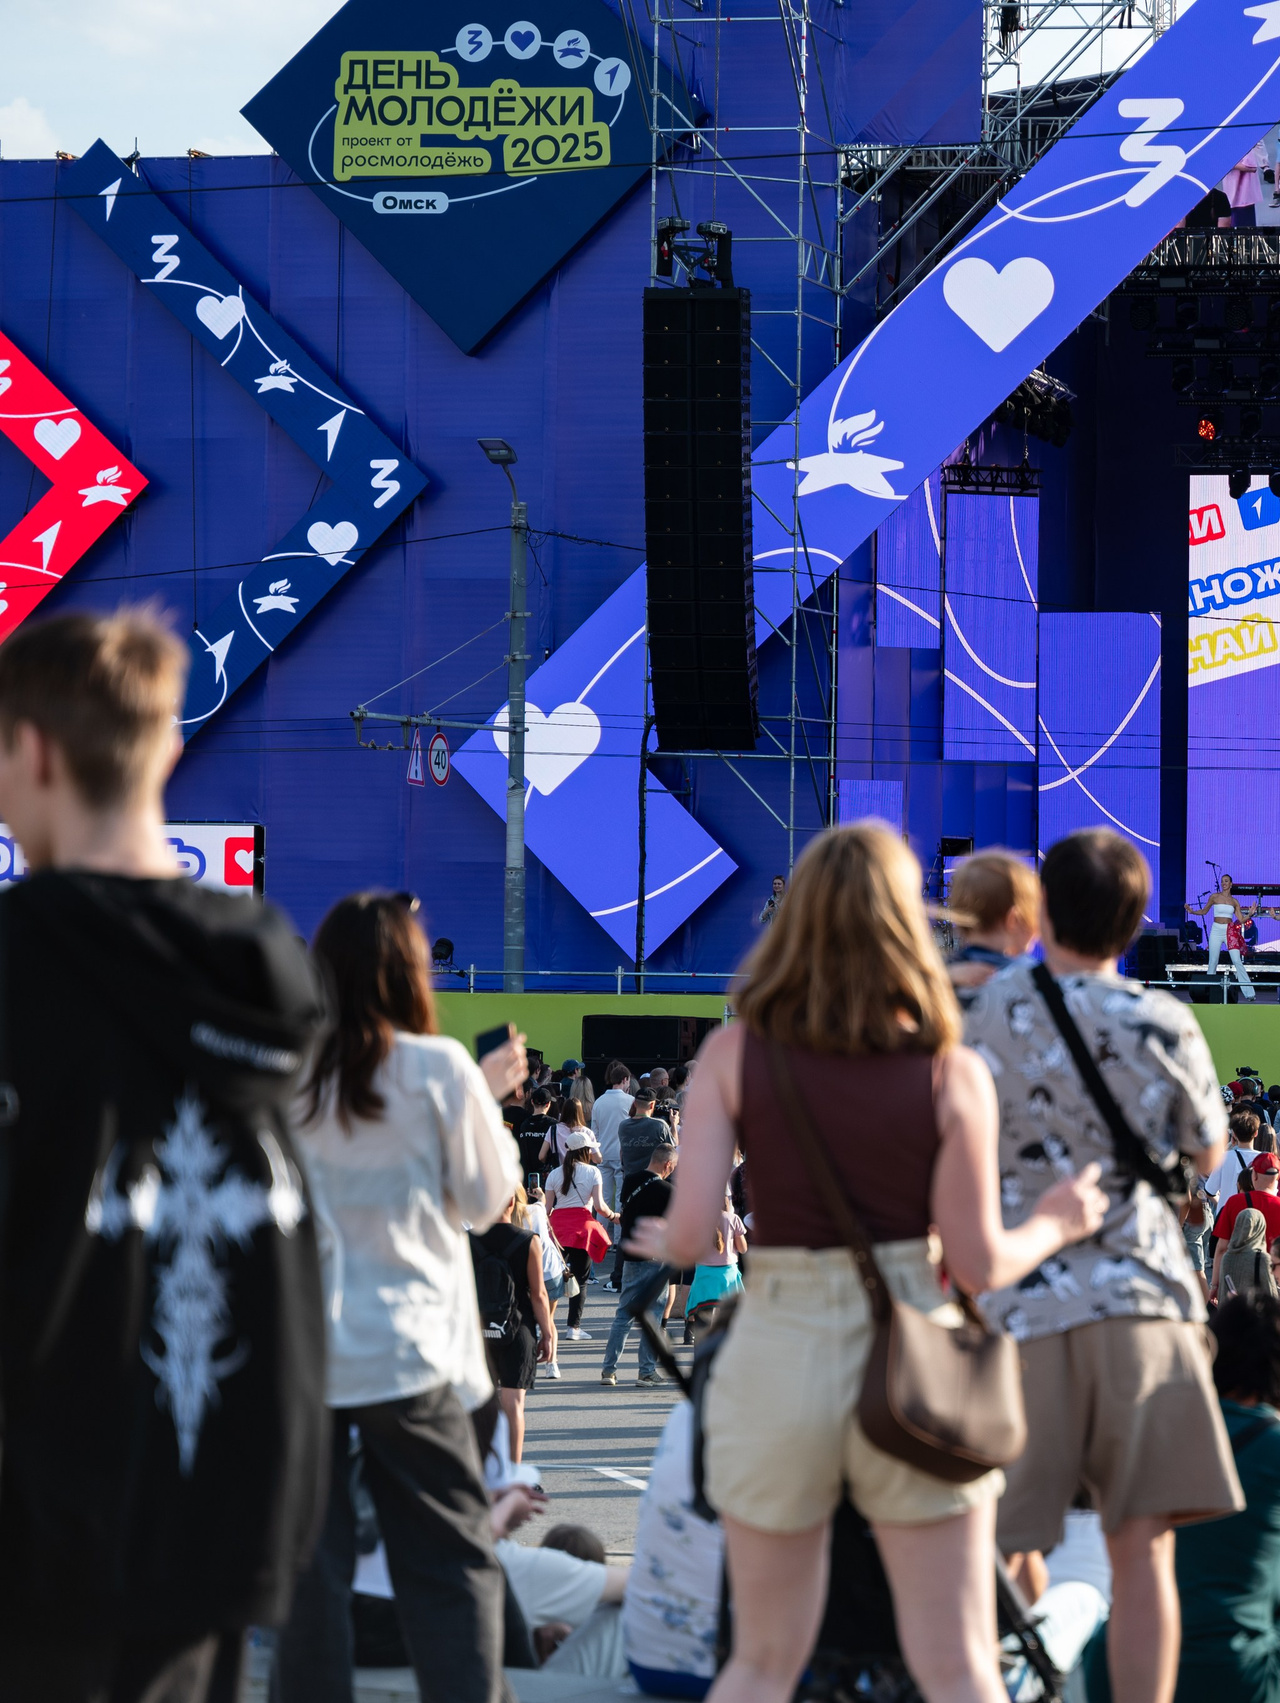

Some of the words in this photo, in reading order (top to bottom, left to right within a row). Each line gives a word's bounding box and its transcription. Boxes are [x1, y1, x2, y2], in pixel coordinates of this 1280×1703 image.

[343, 59, 451, 95] ДЕНЬ
[343, 87, 585, 132] МОЛОДЁЖИ
[342, 135, 392, 150] проект
[396, 135, 413, 147] от
[511, 131, 604, 169] 2025
[341, 151, 484, 174] росмолодёжь
[382, 195, 438, 211] Омск
[434, 750, 446, 770] 40
